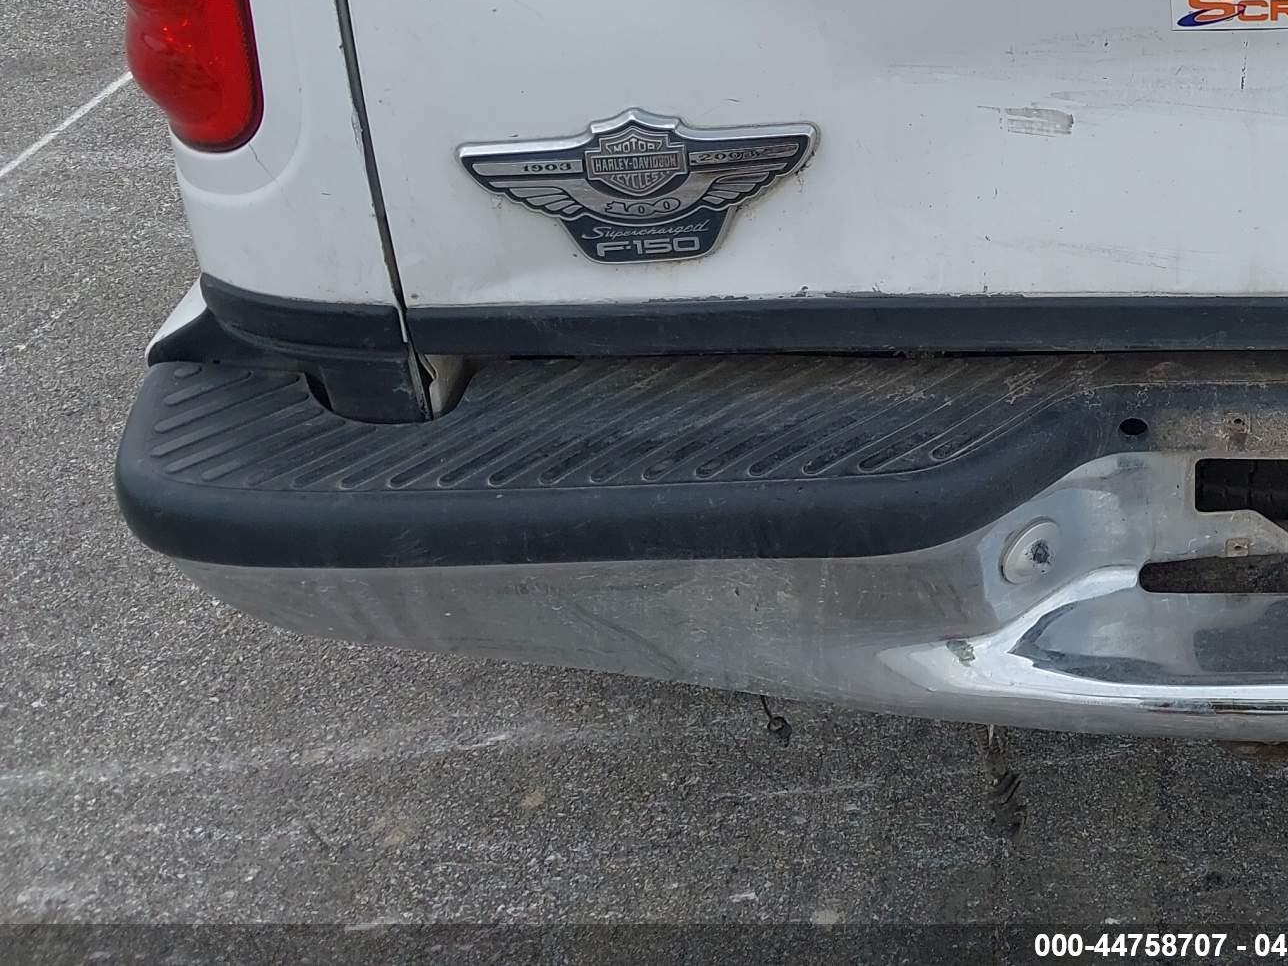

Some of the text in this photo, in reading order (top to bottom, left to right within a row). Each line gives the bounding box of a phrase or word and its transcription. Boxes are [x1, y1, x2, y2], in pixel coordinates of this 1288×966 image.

[613, 138, 655, 153] MOTOR
[521, 161, 572, 173] 1903
[595, 154, 677, 172] HARLEY-DAVIDSON
[617, 173, 658, 189] CYCLES
[581, 219, 711, 240] Supercharged
[596, 236, 700, 257] F-150
